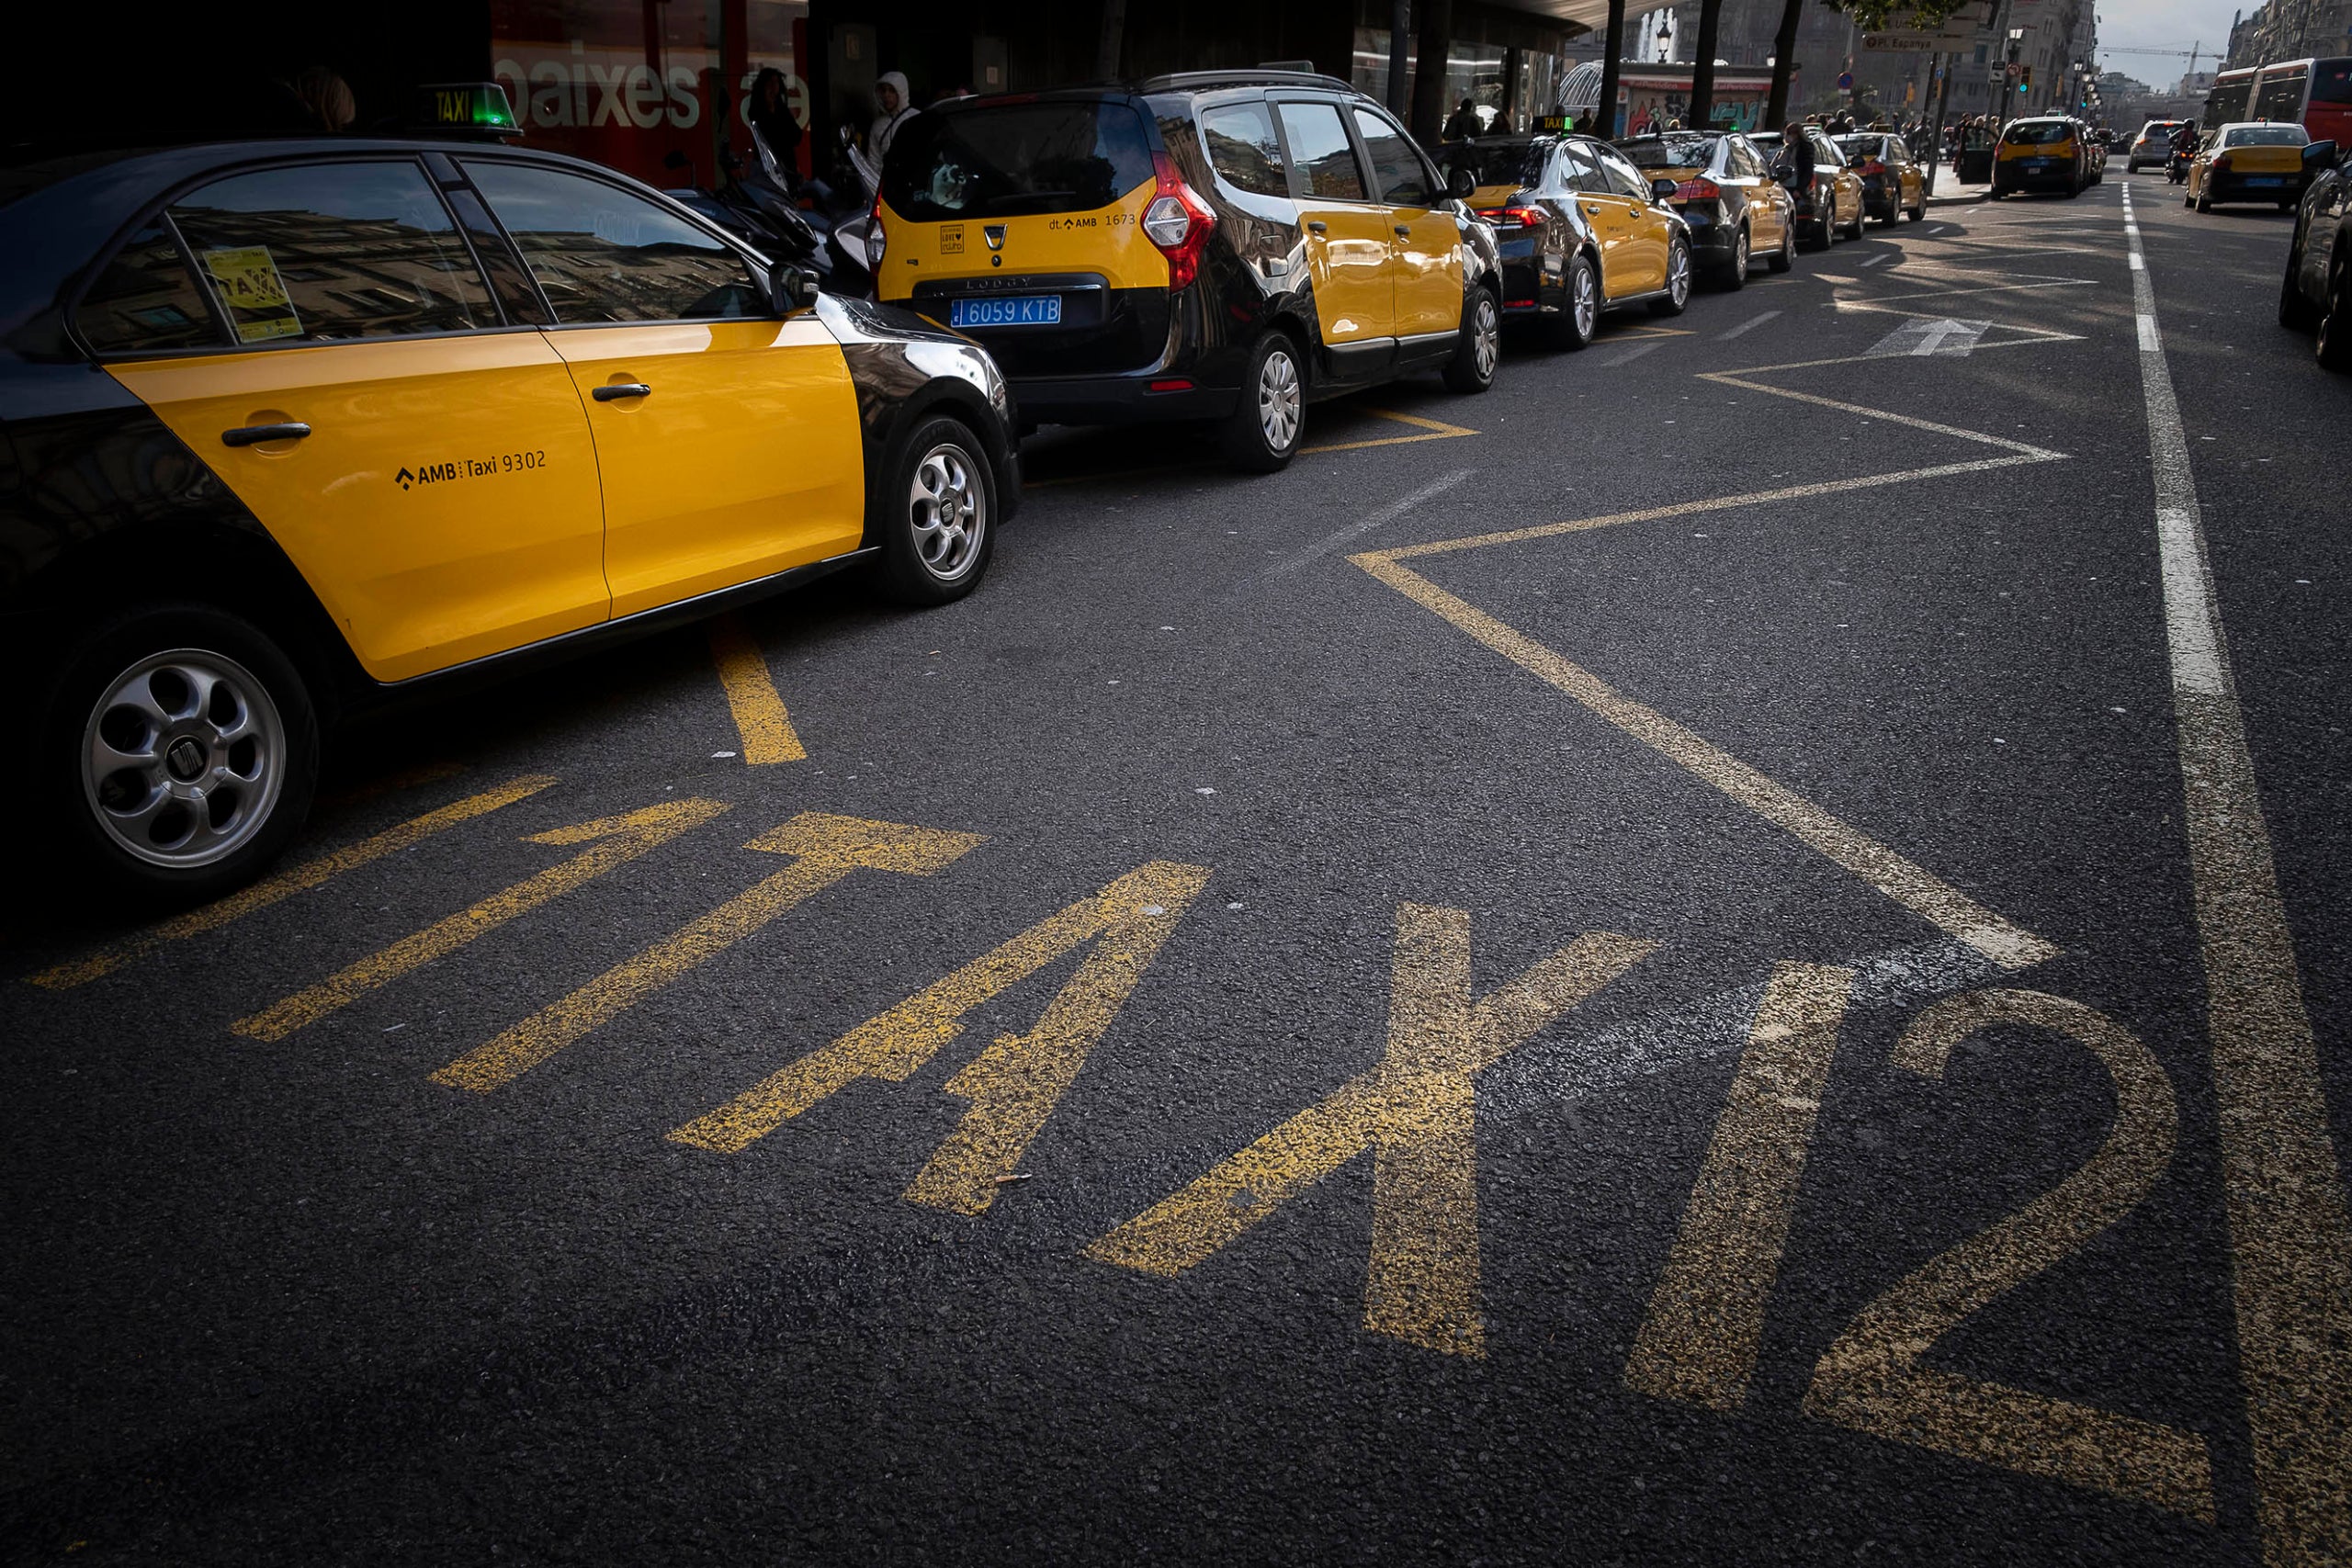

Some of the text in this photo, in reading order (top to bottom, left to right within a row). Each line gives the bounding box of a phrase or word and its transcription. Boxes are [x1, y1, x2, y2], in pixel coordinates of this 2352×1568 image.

[1893, 39, 1931, 50] Espanya
[435, 90, 469, 122] TAXI
[1544, 117, 1563, 129] TAXI
[1076, 218, 1097, 228] AMB
[1105, 214, 1136, 226] 1673
[969, 301, 1015, 322] 6059
[1022, 299, 1058, 321] KTB
[418, 450, 546, 485] AMB Taxi 9302
